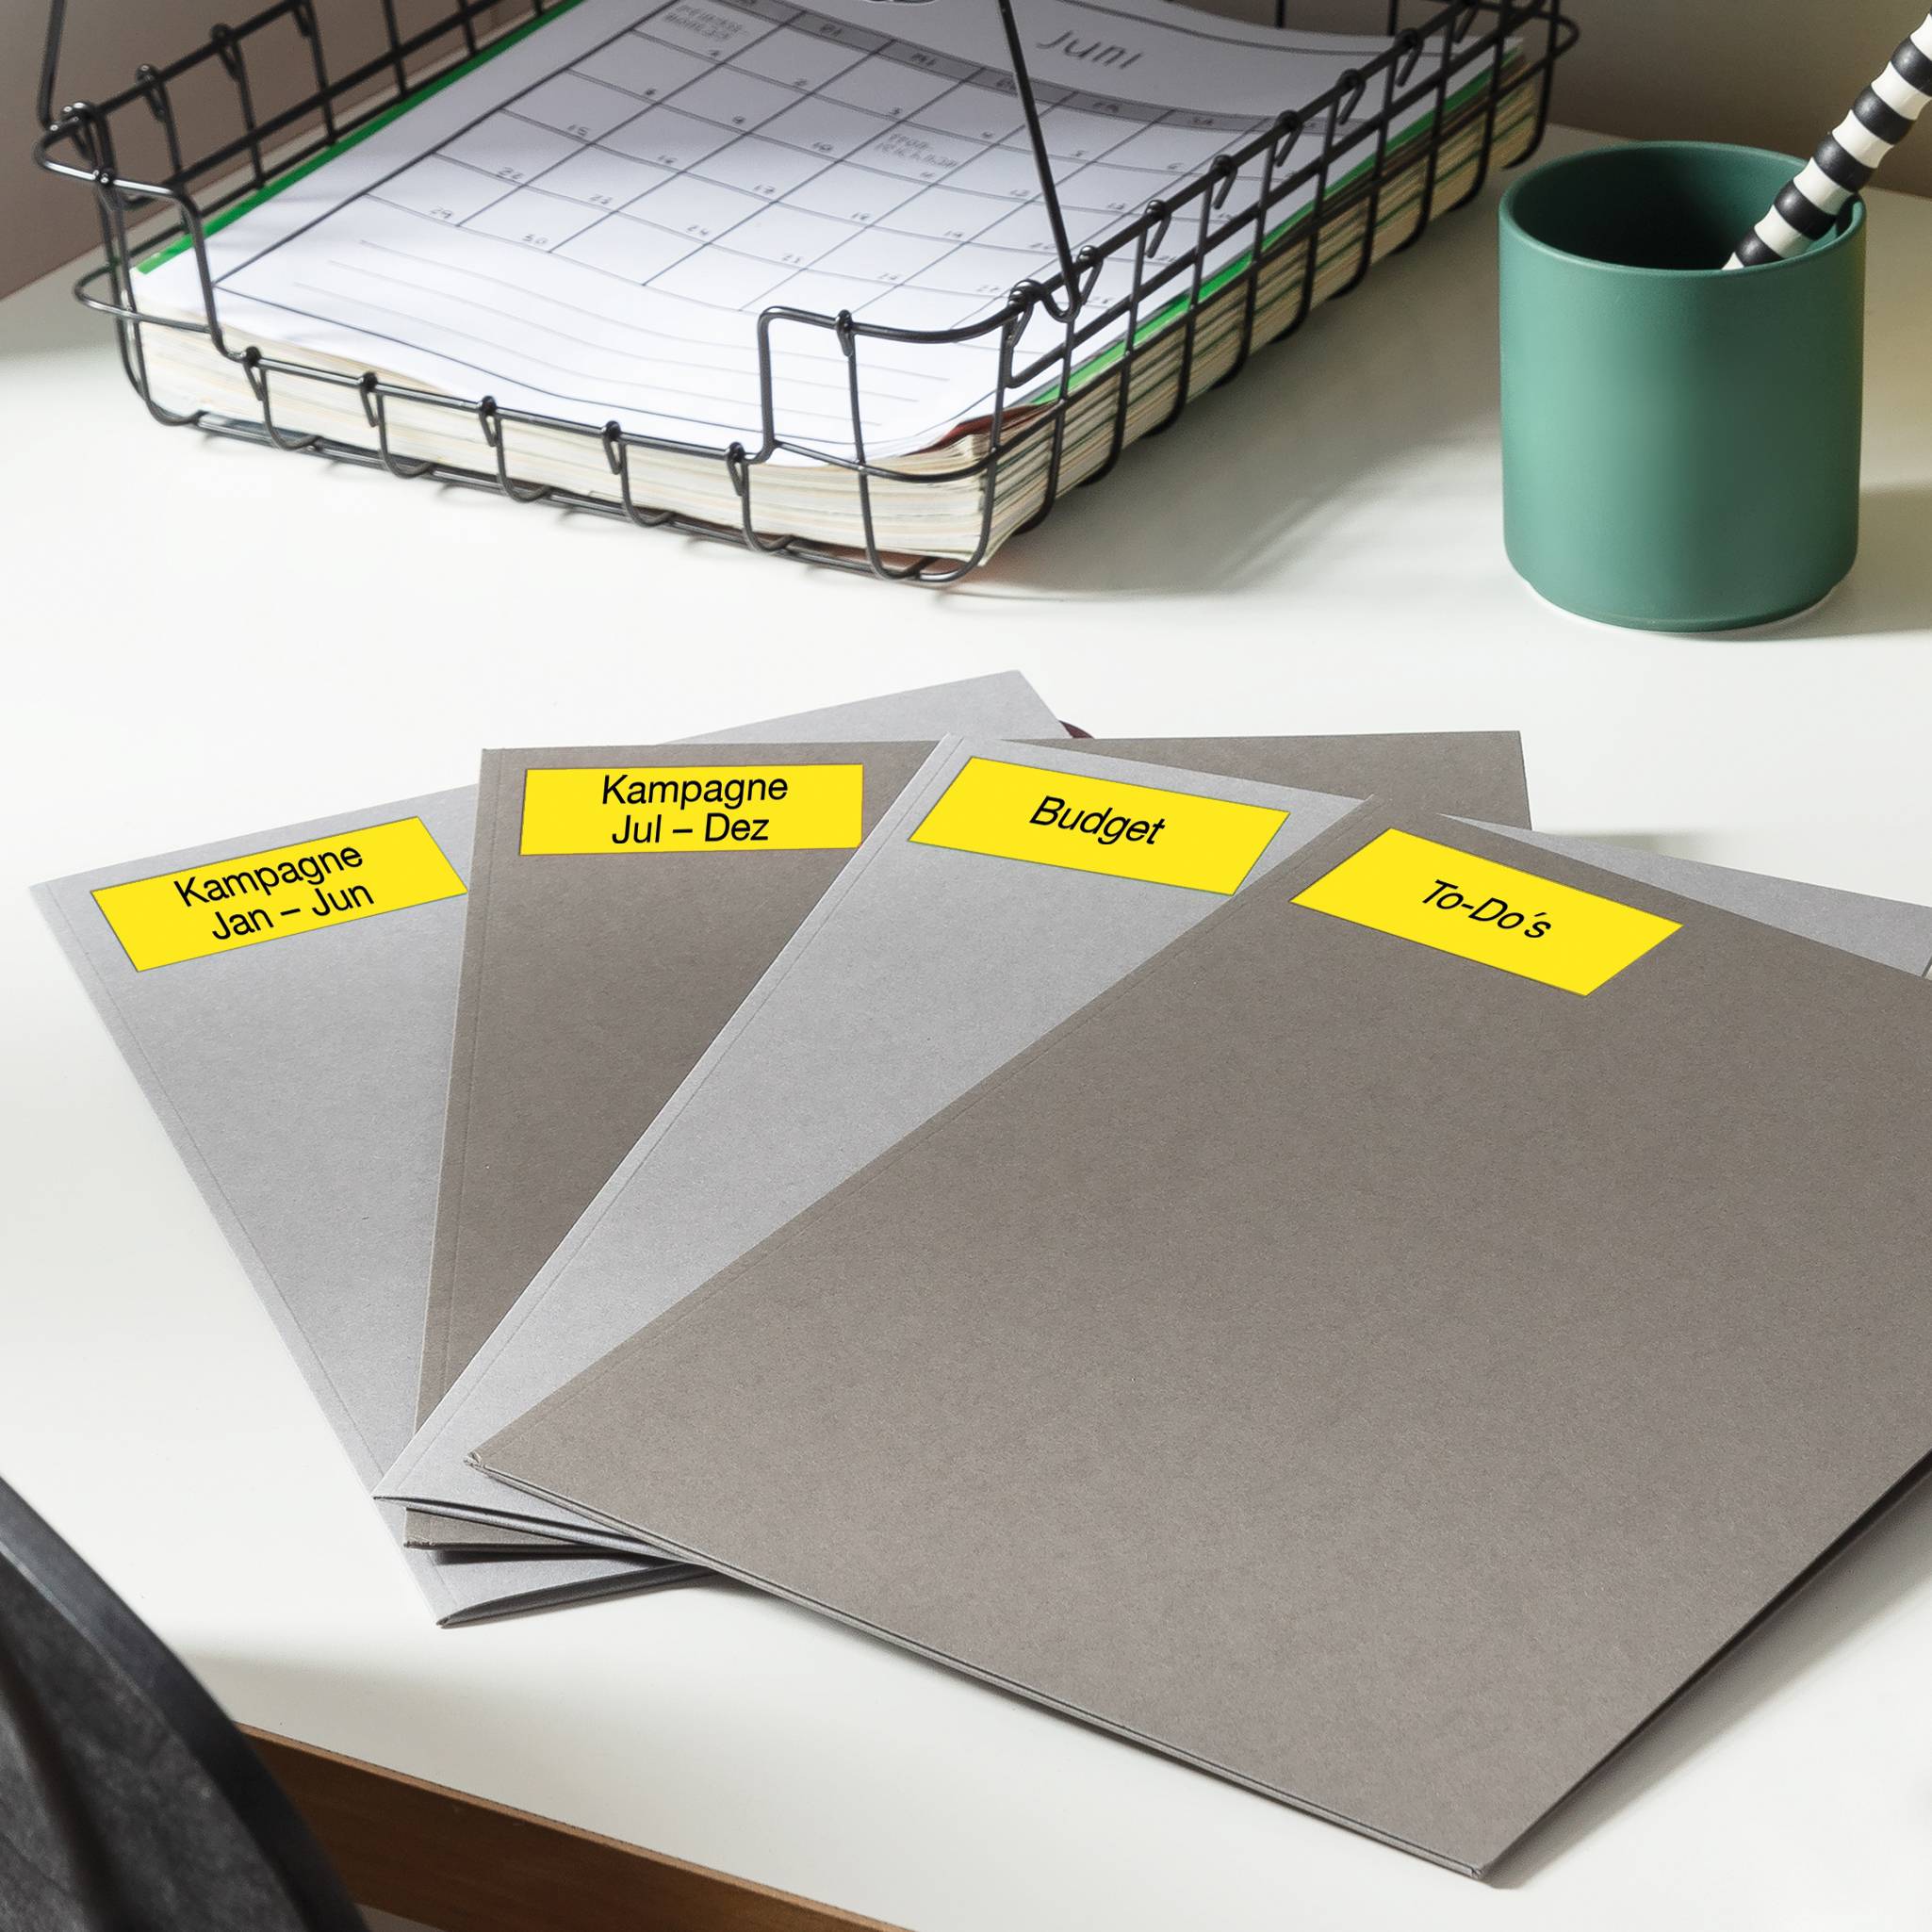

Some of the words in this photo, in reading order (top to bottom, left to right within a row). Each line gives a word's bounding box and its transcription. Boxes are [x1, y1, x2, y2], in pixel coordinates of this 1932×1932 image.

[603, 774, 788, 810] Kampagne
[612, 813, 663, 844] Jul
[704, 812, 770, 843] Dez
[1029, 795, 1167, 846] Budget
[173, 847, 364, 912] Kampagne
[212, 909, 274, 941] Jan
[312, 885, 375, 918] Jun
